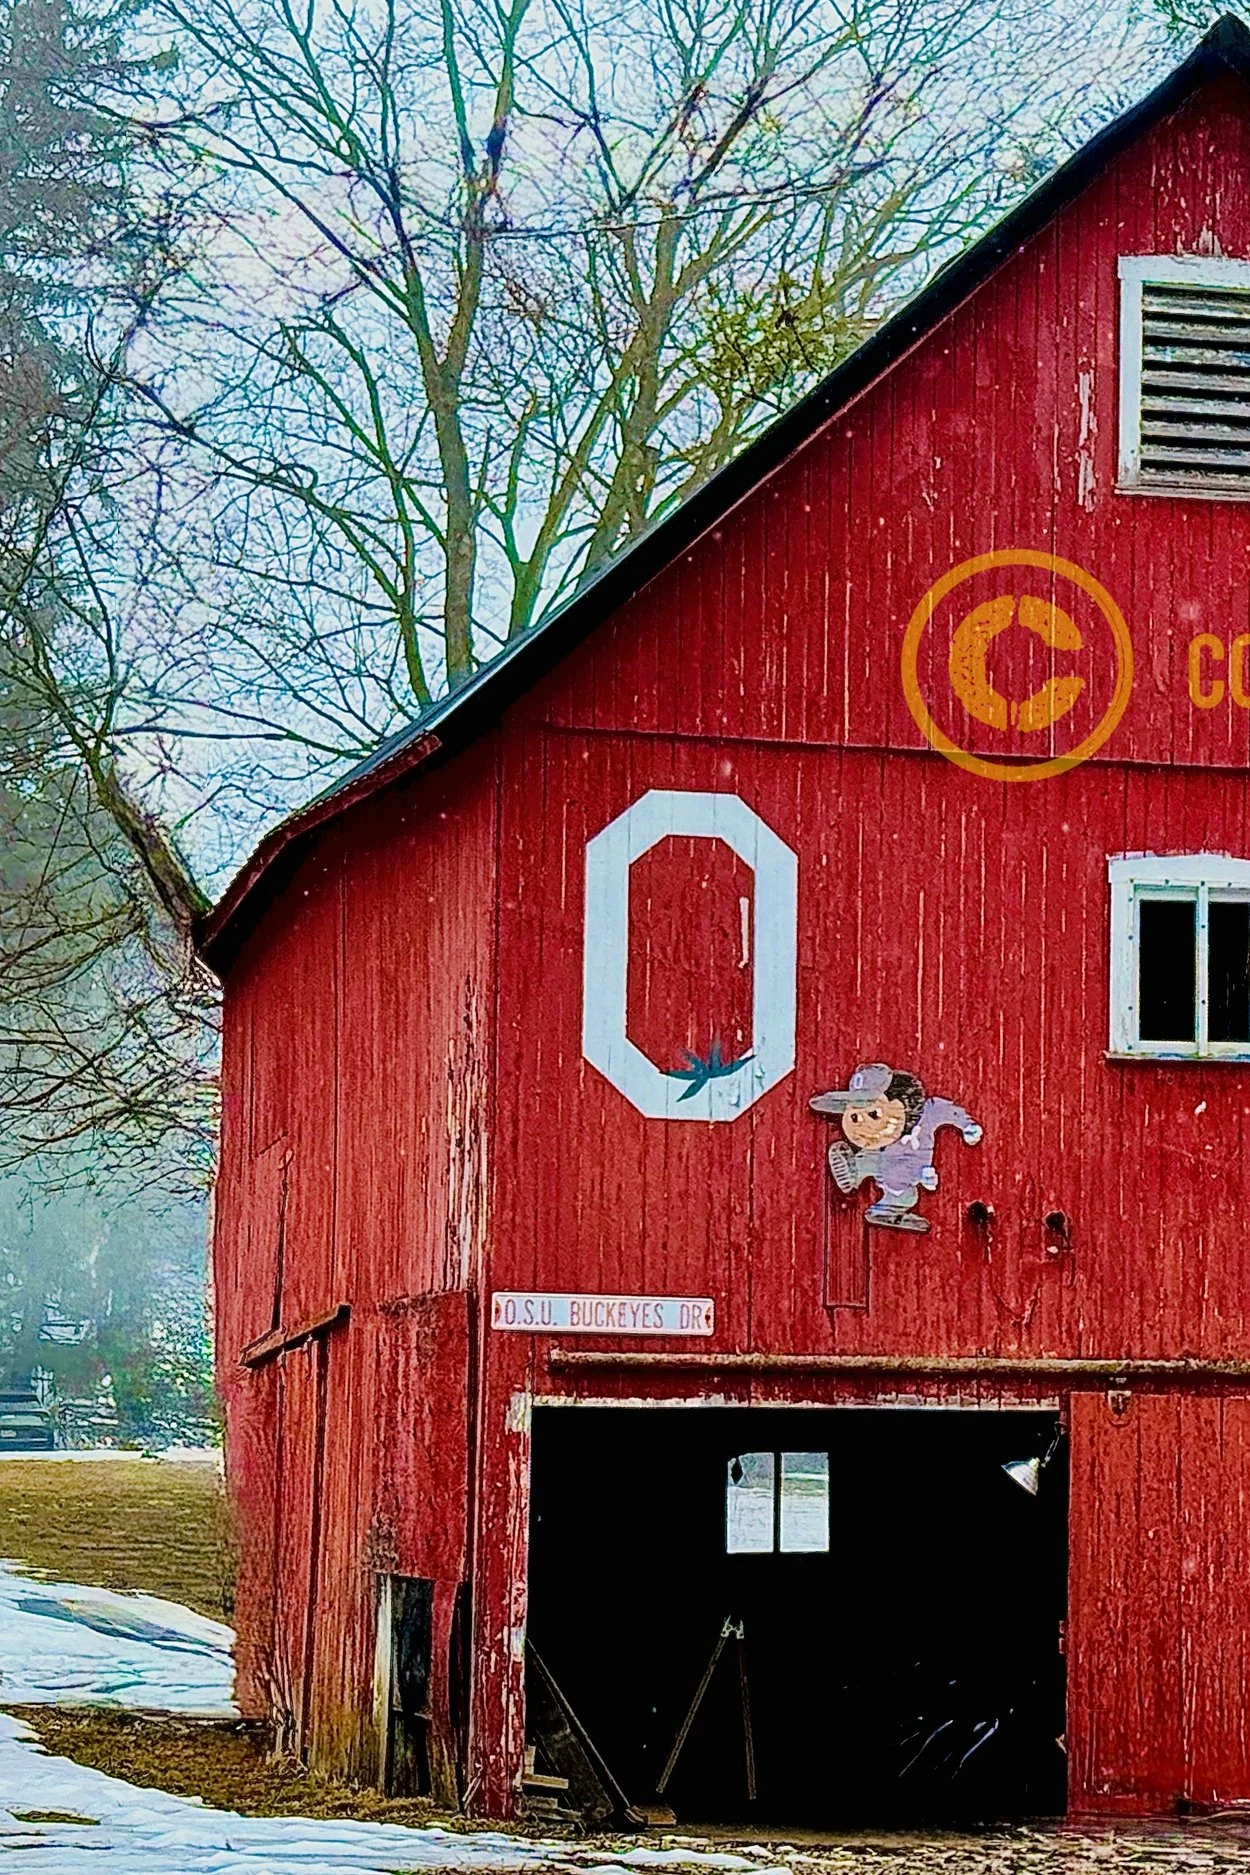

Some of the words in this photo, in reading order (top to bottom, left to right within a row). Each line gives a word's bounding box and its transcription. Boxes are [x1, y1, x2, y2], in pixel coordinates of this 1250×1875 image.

[504, 1299, 558, 1326] O.S.U.
[569, 1301, 664, 1329] BUCKEYES
[679, 1304, 702, 1330] DR
